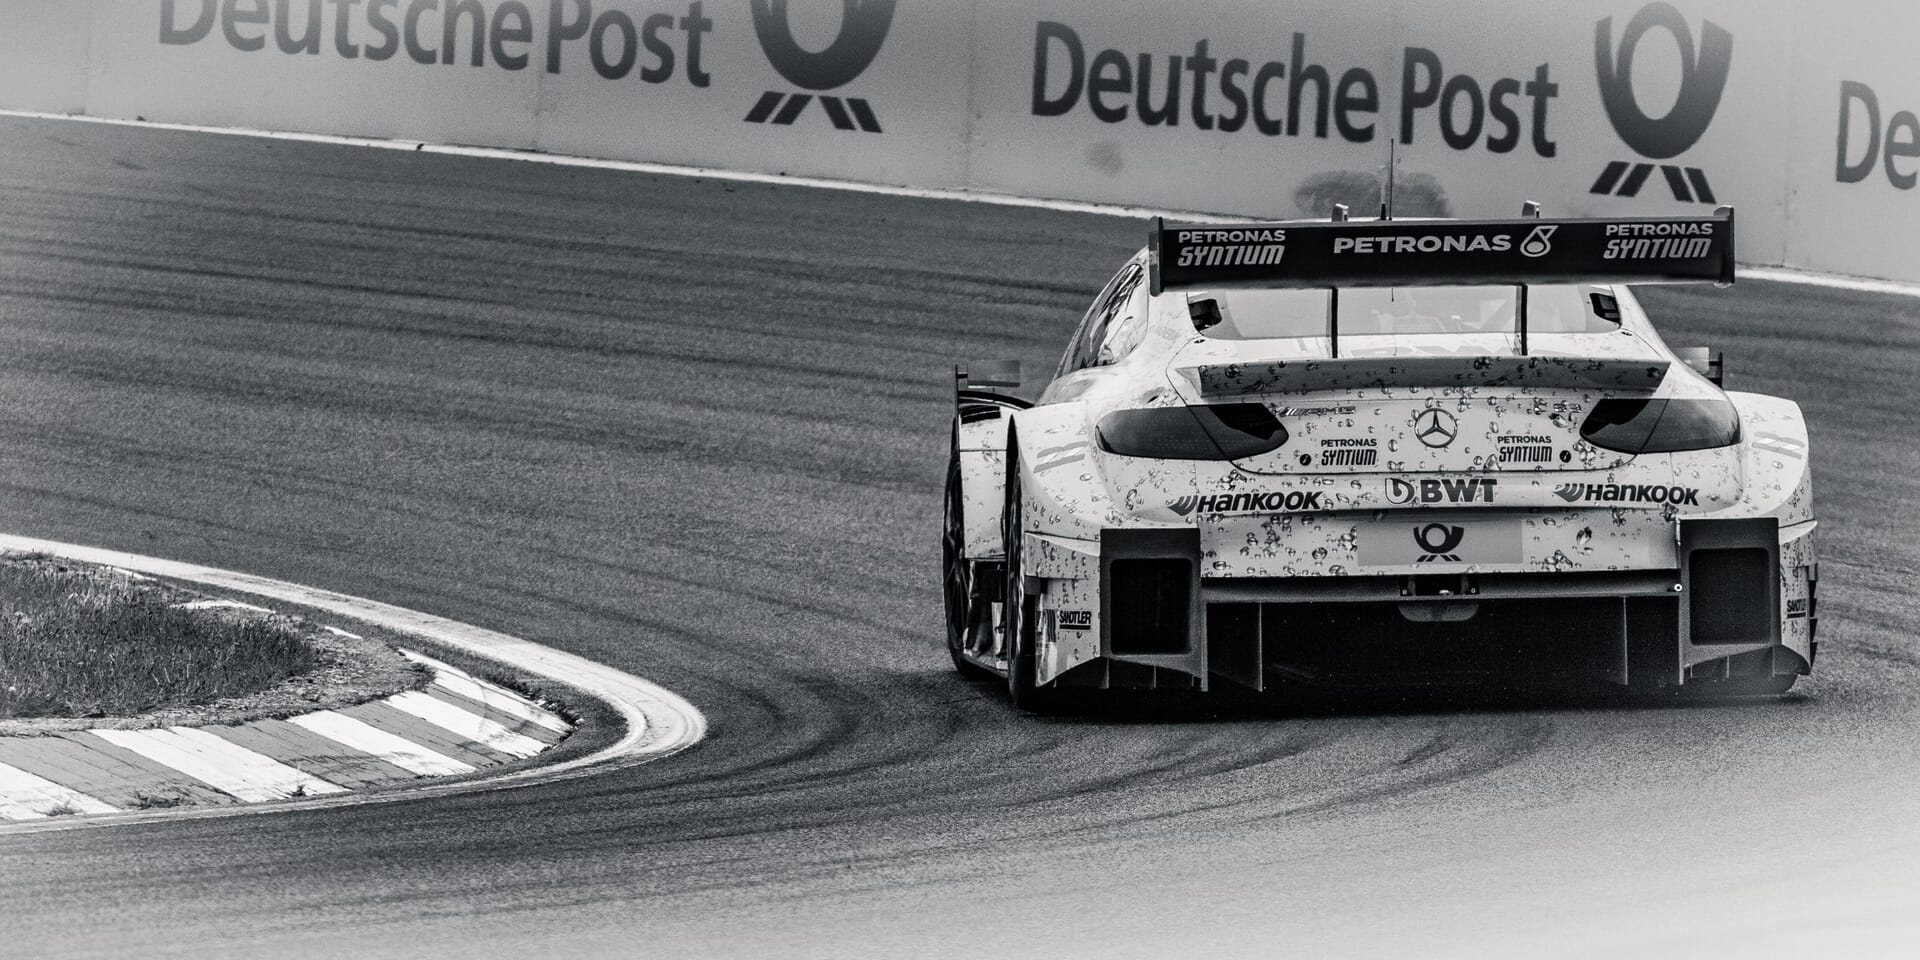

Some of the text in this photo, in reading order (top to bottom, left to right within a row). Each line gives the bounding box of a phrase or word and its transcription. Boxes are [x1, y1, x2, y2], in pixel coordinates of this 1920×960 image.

[158, 0, 713, 88] Deutsche Post
[1030, 20, 1558, 158] Deutsche Post
[1179, 230, 1286, 243] PETRONAS
[1606, 223, 1713, 236] PETRONAS
[1334, 234, 1511, 254] PETRONAS
[1603, 238, 1711, 259] SYNTIUM
[1178, 245, 1285, 266] SYNTIUM
[1321, 438, 1377, 447] PETRONAS
[1497, 435, 1552, 443] PETRONAS
[1321, 449, 1377, 466] SYNTIUM
[1499, 446, 1552, 462] SYNTIUM
[1420, 478, 1498, 503] BWT
